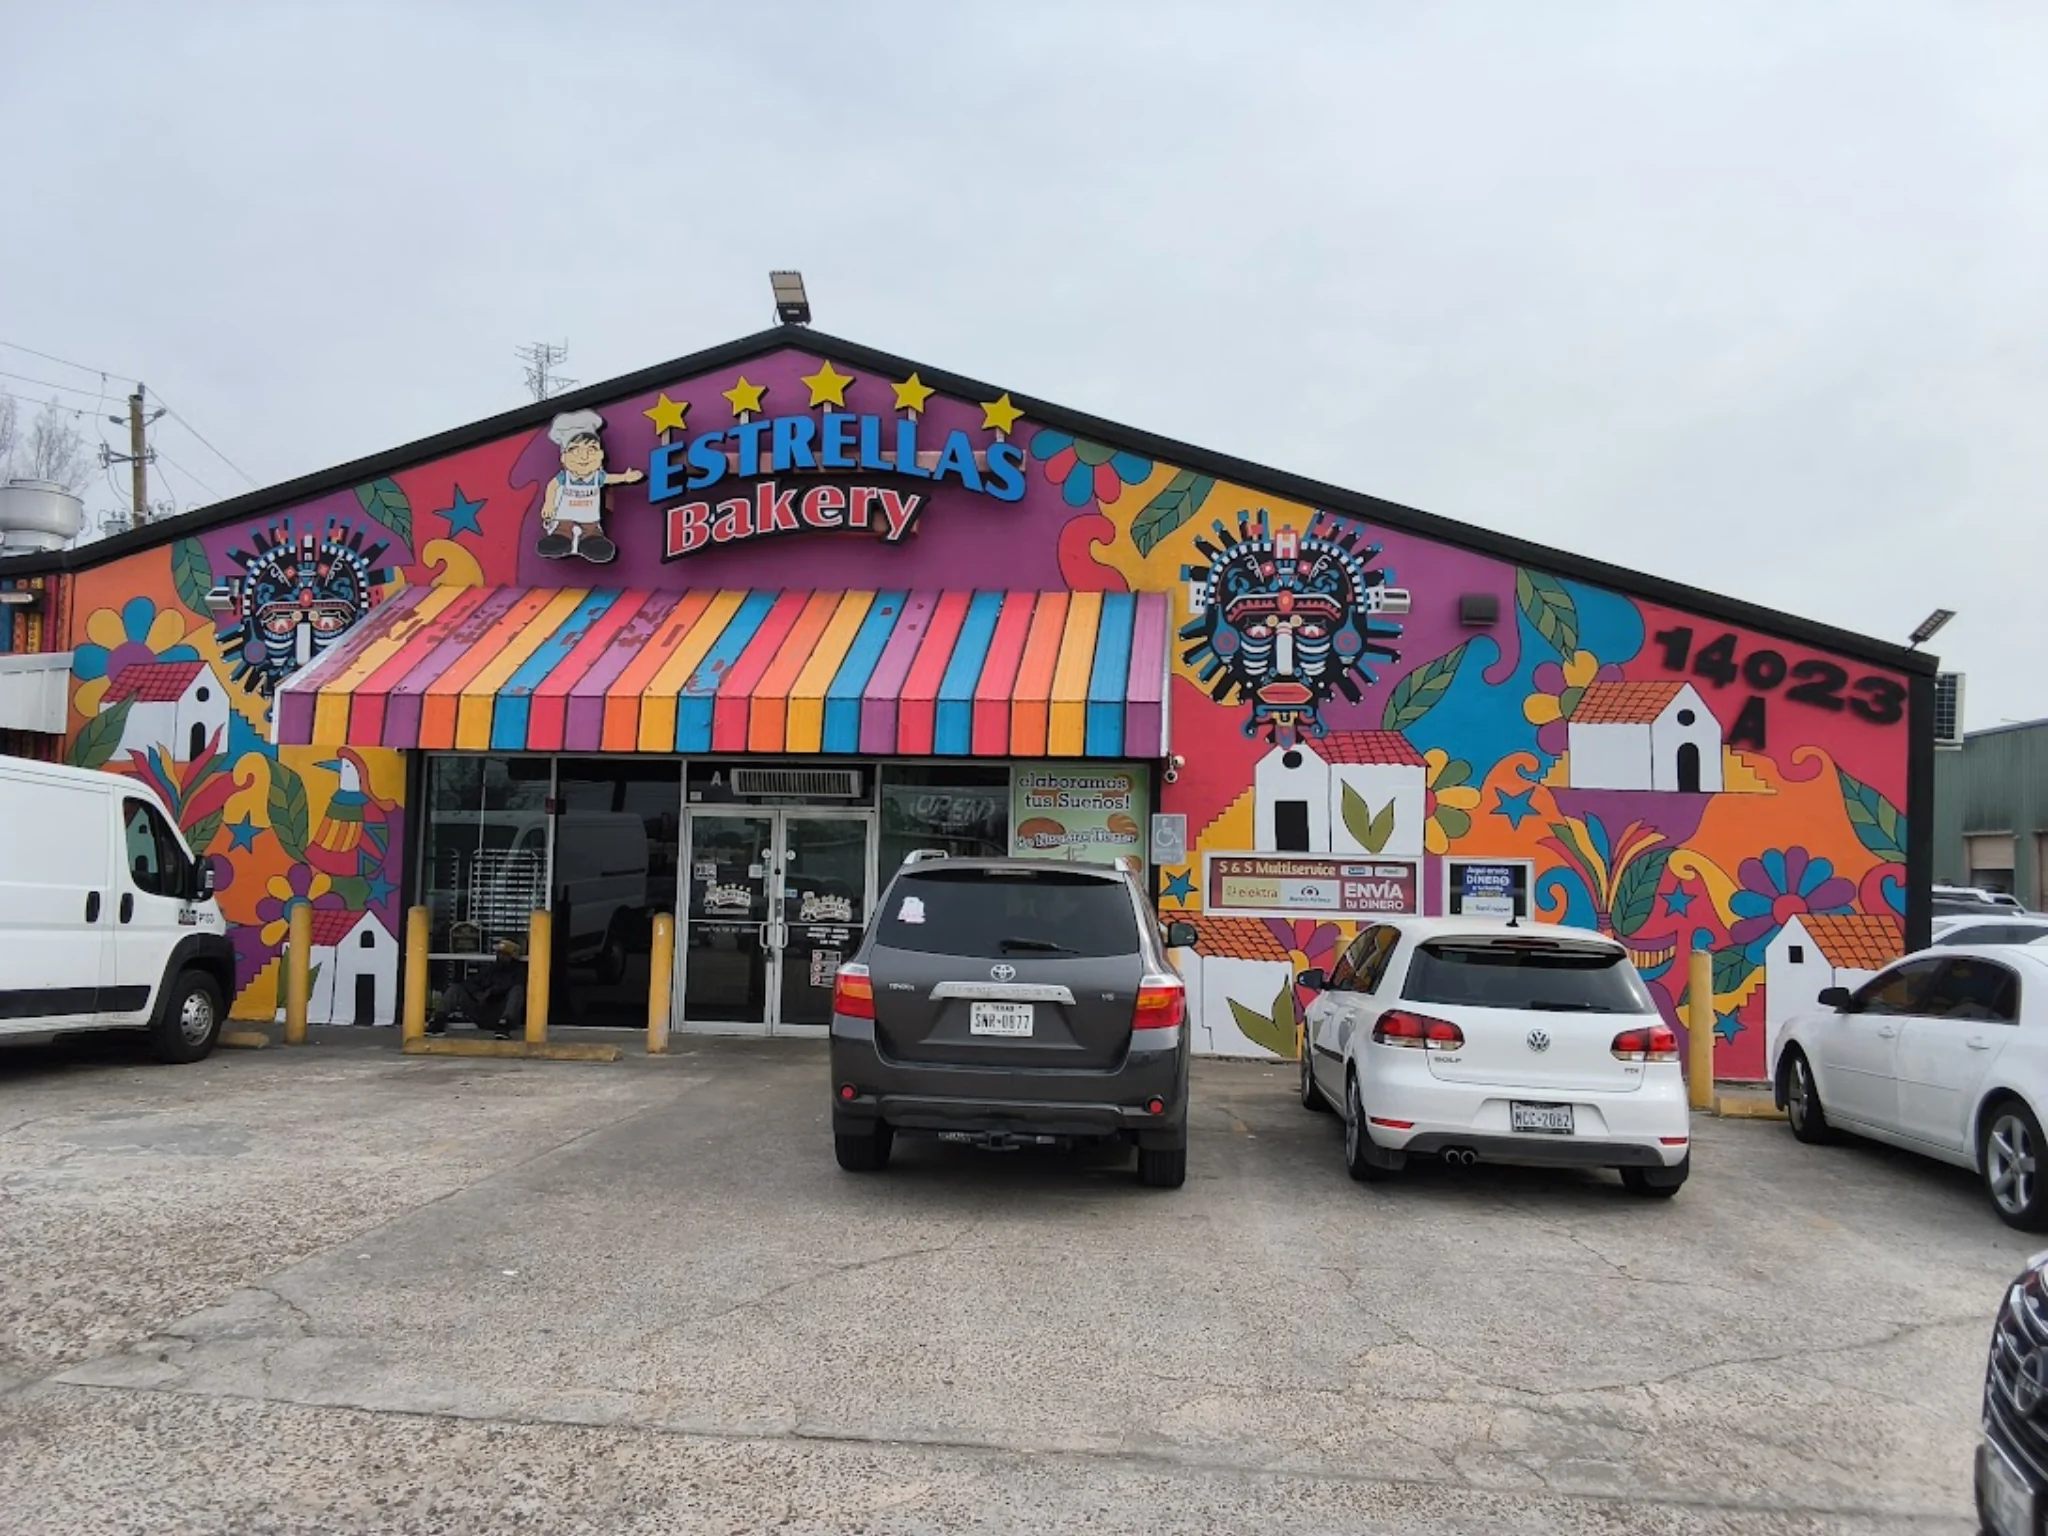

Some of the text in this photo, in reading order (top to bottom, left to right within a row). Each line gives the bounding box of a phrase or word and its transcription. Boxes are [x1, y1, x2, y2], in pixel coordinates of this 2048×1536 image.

[648, 413, 1027, 503] ESTRELLAS
[666, 481, 920, 557] Bakery
[1655, 626, 1907, 725] 14023
[1729, 696, 1766, 750] A
[711, 770, 722, 787] A
[1019, 771, 1128, 789] elaboramos
[1025, 792, 1130, 809] tus Sueños!
[1219, 861, 1229, 874] S
[1231, 862, 1241, 874] &
[1244, 861, 1253, 874] S
[1256, 861, 1336, 876] Multiservice
[1344, 880, 1404, 899] ENVÍA
[1466, 875, 1510, 886] DINERO
[1346, 899, 1404, 910] tu DINERO
